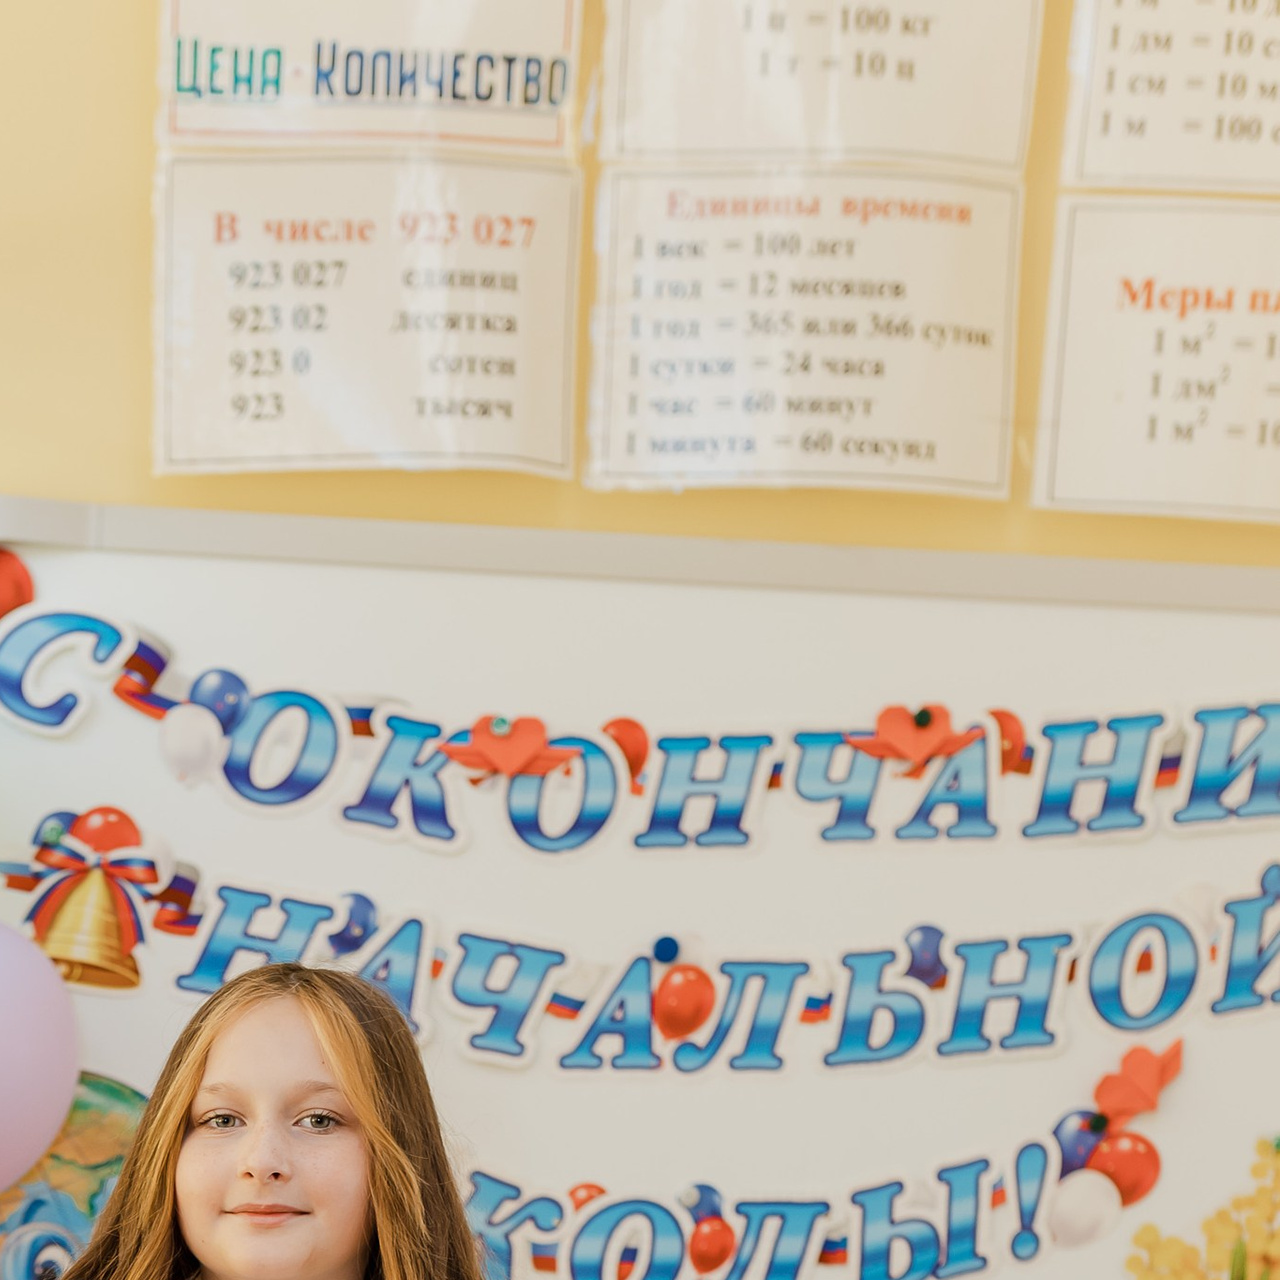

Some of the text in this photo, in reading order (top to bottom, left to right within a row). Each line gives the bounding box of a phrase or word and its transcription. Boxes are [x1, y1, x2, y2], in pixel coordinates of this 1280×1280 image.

[840, 6, 891, 34] 100
[1224, 28, 1256, 57] 10
[854, 49, 887, 79] 10
[1218, 71, 1248, 101] 10
[1215, 114, 1263, 143] 100
[212, 212, 536, 249] В числе 923 027
[229, 261, 282, 291] 923
[292, 260, 348, 291] 027
[1119, 276, 1280, 323] Меры п
[229, 304, 282, 335] 923
[291, 303, 328, 333] 02
[229, 349, 282, 378] 923
[291, 348, 311, 375] 0
[231, 393, 284, 422] 923
